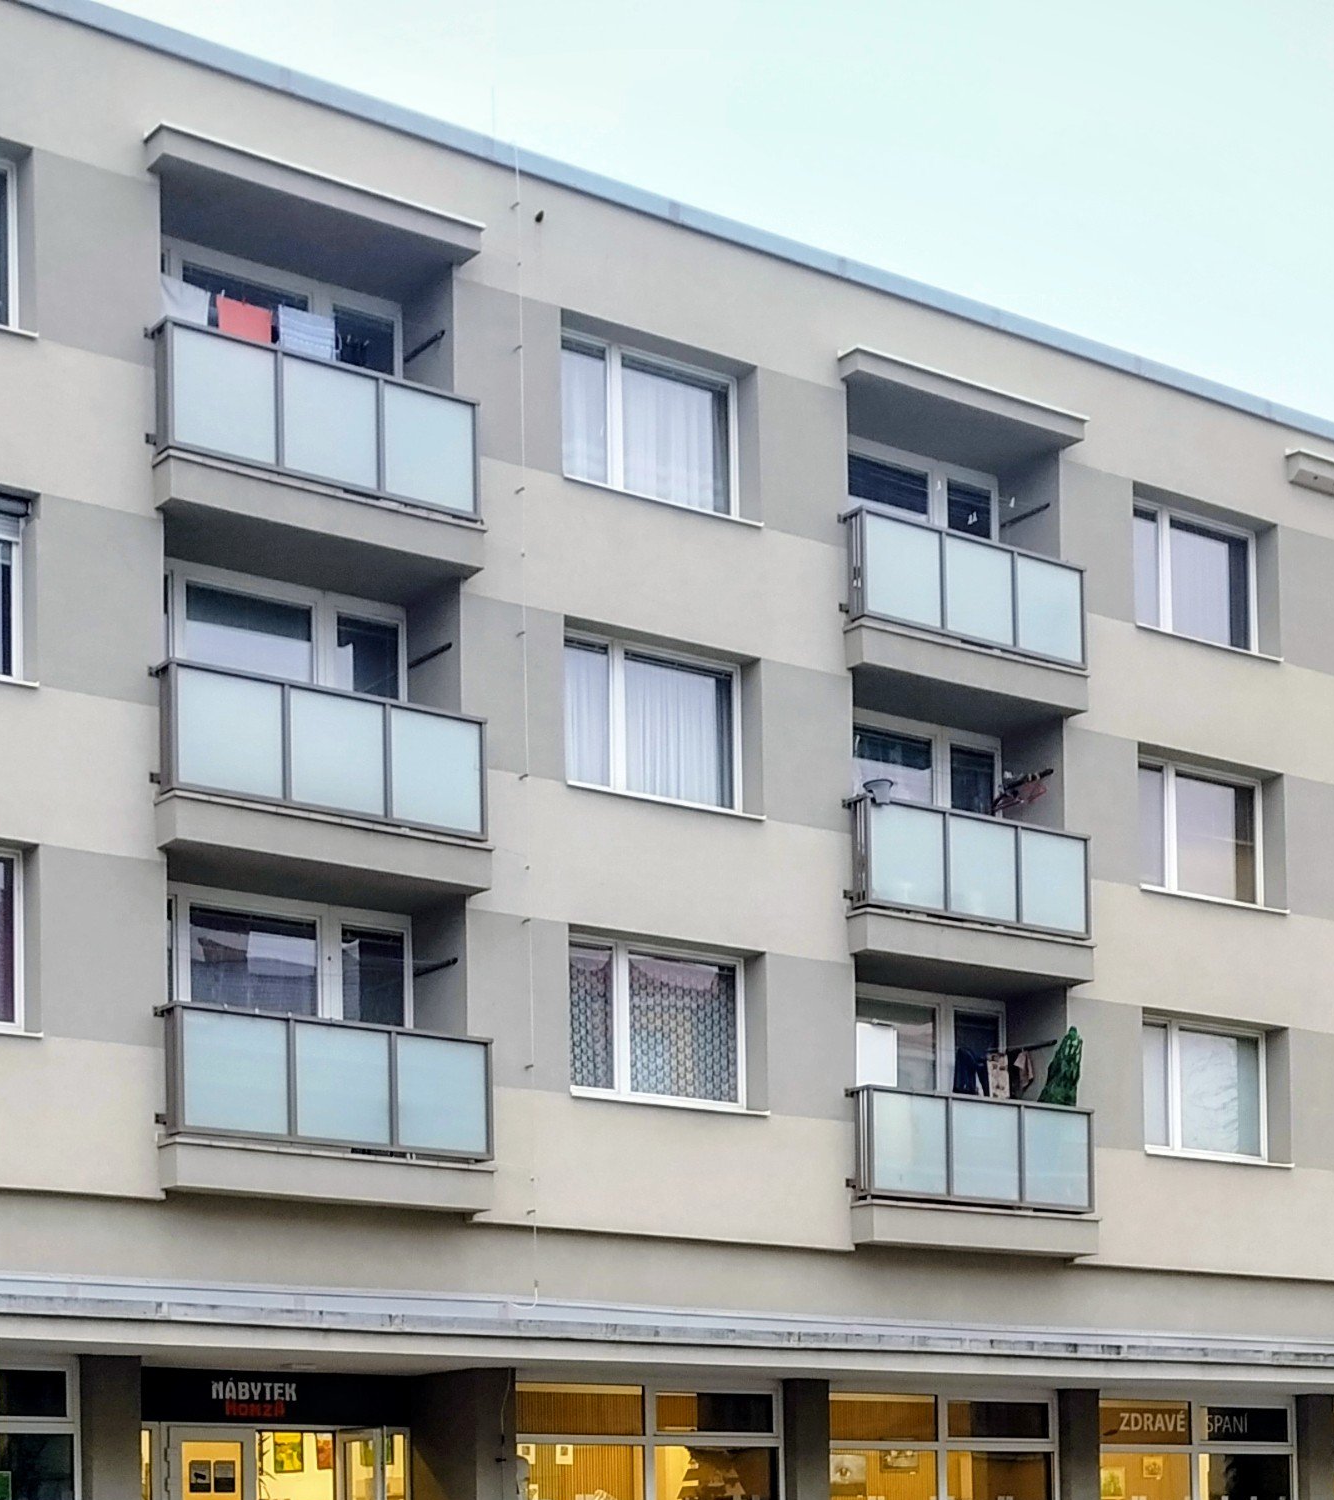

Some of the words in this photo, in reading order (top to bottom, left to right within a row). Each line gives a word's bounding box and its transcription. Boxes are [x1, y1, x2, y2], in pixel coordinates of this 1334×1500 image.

[211, 1377, 297, 1401] NÁBYTEK
[1120, 1410, 1186, 1432] ZDRAVÉ
[1206, 1412, 1248, 1433] SPANÍ
